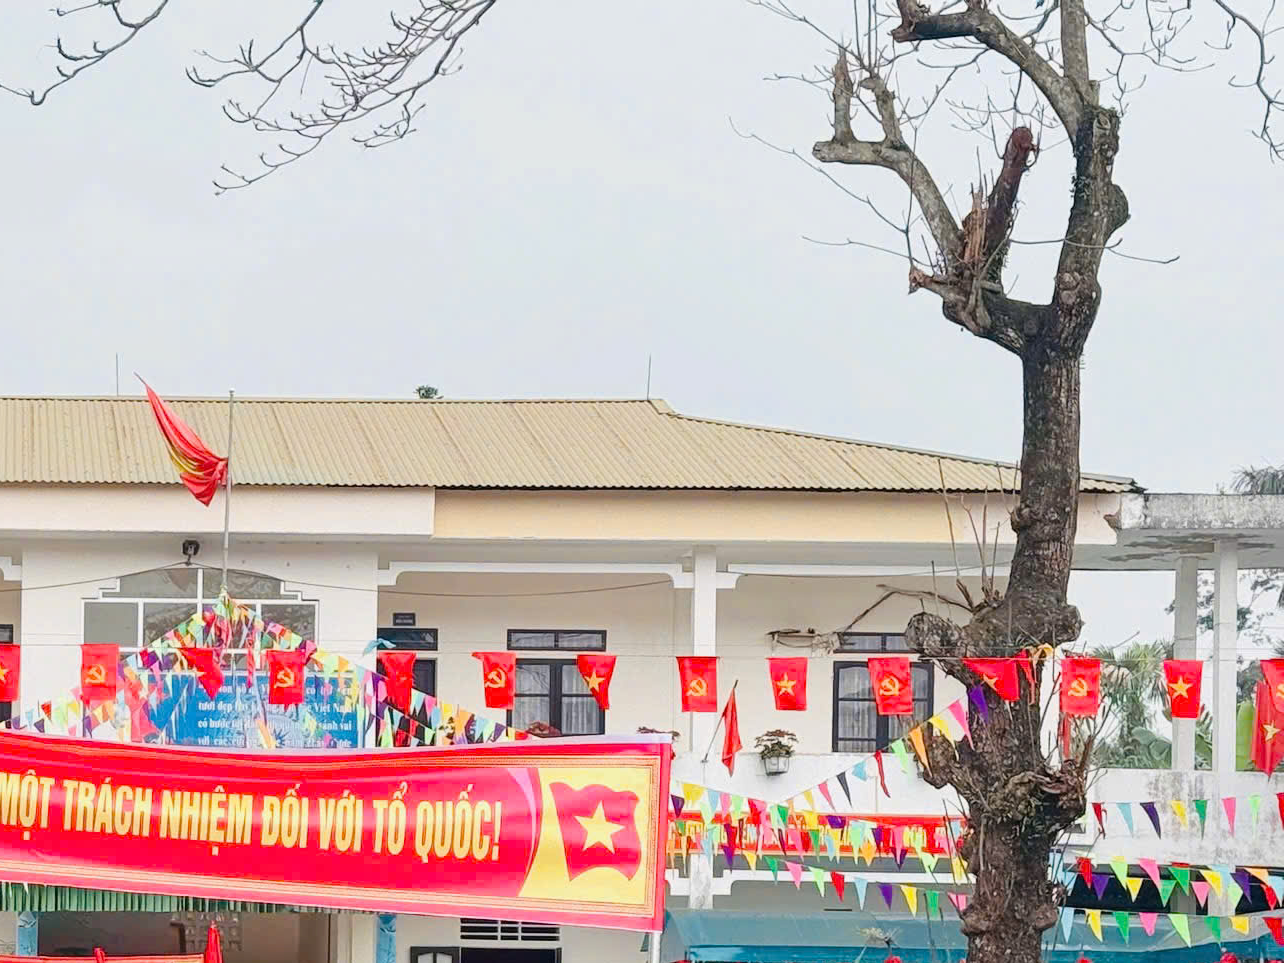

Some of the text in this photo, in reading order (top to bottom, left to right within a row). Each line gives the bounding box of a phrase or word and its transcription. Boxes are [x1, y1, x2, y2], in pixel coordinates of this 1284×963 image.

[63, 776, 153, 838] TRÁCH
[159, 784, 254, 857] NHIỆM
[260, 783, 309, 849] ĐỐI
[318, 789, 365, 853] VỚI
[372, 781, 409, 856] TỔ
[414, 783, 502, 864] QUỐC!
